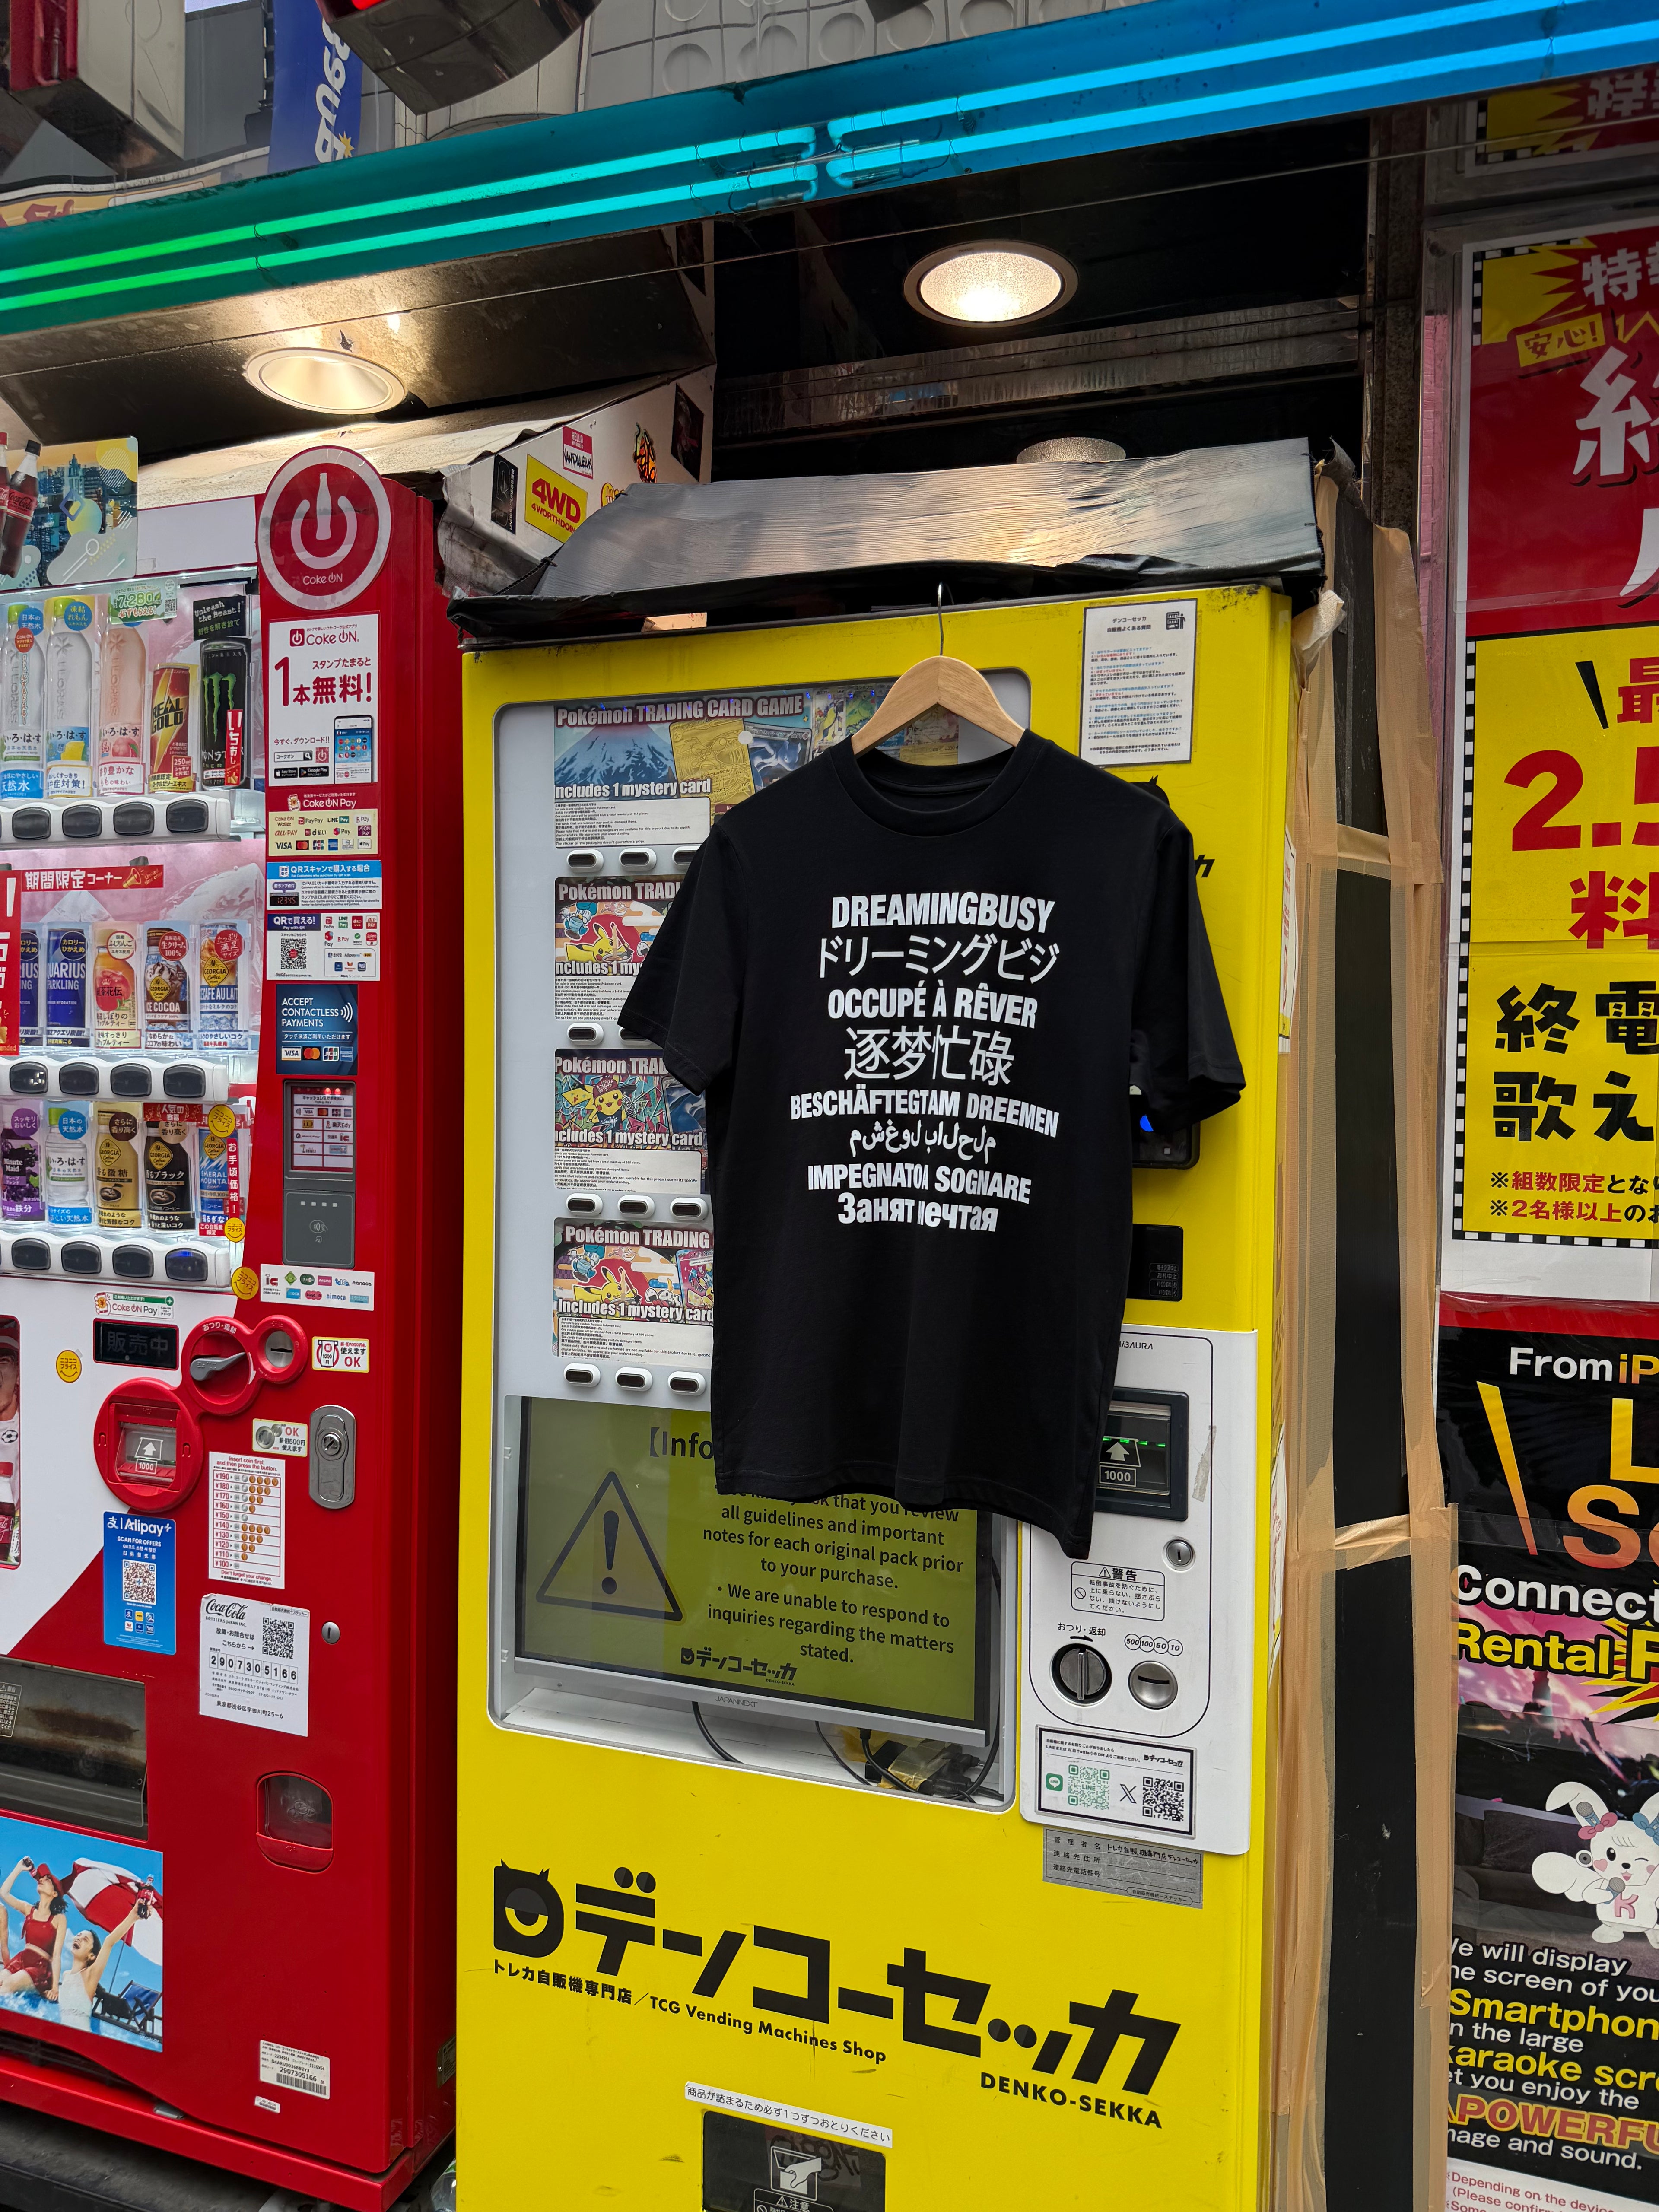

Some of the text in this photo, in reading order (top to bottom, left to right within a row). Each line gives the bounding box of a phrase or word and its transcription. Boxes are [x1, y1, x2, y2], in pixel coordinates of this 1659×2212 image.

[1524, 320, 1600, 360] 安心!
[532, 478, 581, 524] 4WD
[303, 572, 343, 585] Coke ON
[195, 601, 225, 617] Unleash
[213, 602, 241, 620] Beast!
[306, 629, 358, 645] Coke ON
[312, 657, 372, 670] スタンプたまると
[274, 656, 372, 707] 1本無料!
[557, 695, 802, 726] Pokémon TRADING CARD GAME
[613, 778, 711, 799] 1 mystery card
[303, 798, 357, 809] Coke ON Pay
[25, 869, 123, 890] 期間限定コーナー
[291, 864, 370, 874] QRスキャンで購入する場合
[559, 883, 632, 901] Pokémon
[832, 892, 1055, 934] DREAMINGBUSY
[819, 933, 1060, 984] ドリーミングビジ
[154, 1002, 180, 1012] COCOA
[282, 998, 313, 1006] ACCEPT
[282, 1008, 339, 1017] CONTACTLESS
[828, 979, 1038, 1029] OCCUPÉ À RÊVER
[282, 1019, 324, 1027] PAYMENTS
[844, 1024, 1015, 1086] 逐梦忙碌
[966, 1093, 1060, 1138] DREEMEN
[1493, 1069, 1655, 1143] 歌え
[615, 1131, 702, 1147] mystery card
[934, 1166, 1032, 1204] SOGNARE
[1491, 1170, 1659, 1195] ※組数限定とな
[838, 1192, 915, 1224] Занят
[566, 1226, 709, 1249] Pokémon TRADING
[112, 1303, 157, 1316] Coke ON Pay
[558, 1298, 713, 1322] Includes 1 mystery card
[108, 1331, 169, 1356] 販売中
[344, 1357, 361, 1367] OK
[1510, 1347, 1612, 1382] From
[138, 1462, 154, 1471] 1000
[833, 1494, 866, 1511] that
[870, 1498, 900, 1517] you
[721, 1505, 944, 1546] all guidelines and important
[703, 1529, 964, 1573] notes for each original pack prior
[761, 1558, 898, 1590] to your purchase.
[1112, 1567, 1137, 1581] 警告
[728, 1584, 950, 1628] We are unable to respond to
[707, 1604, 954, 1653] inquiries regarding the matters
[1057, 1623, 1106, 1637] おつり・返却
[222, 1640, 246, 1649] こちらから
[800, 1644, 854, 1663] stated.
[1457, 1621, 1611, 1675] Rental
[1054, 1850, 1101, 1864] 連絡先住所
[1482, 1943, 1628, 1977] will display
[576, 1866, 1182, 2095] デンコーセッカ
[1484, 1968, 1573, 1993] screen
[1581, 1979, 1609, 1997] of
[650, 1996, 681, 2015] TCG
[686, 2004, 753, 2034] Vending
[758, 2020, 838, 2051] Machines
[842, 2040, 887, 2065] Shop
[1472, 2022, 1584, 2053] the large
[981, 2071, 1163, 2130] DENKO-SEKKA
[1470, 2073, 1640, 2110] you enjoy the
[1508, 2137, 1642, 2170] and sound.
[1452, 2172, 1566, 2206] Depending on the
